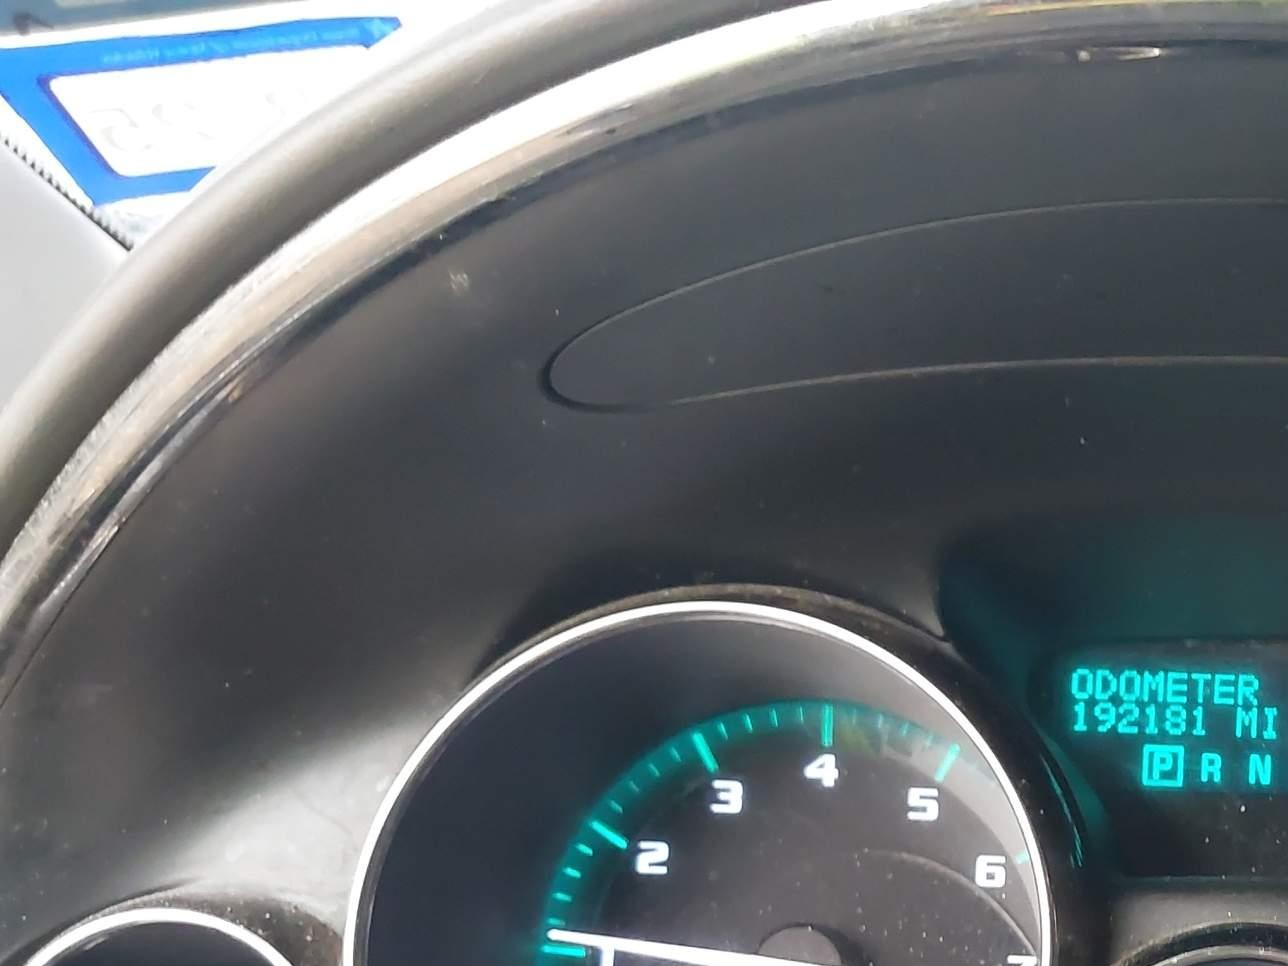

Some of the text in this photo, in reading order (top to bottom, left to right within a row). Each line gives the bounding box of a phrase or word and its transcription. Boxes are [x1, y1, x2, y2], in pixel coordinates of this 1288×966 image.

[1070, 667, 1260, 705] ODOMETER
[1073, 702, 1278, 740] 192181 MI
[804, 754, 839, 787] 4
[1151, 752, 1174, 782] P
[1200, 752, 1222, 783] R
[1248, 753, 1272, 785] N
[709, 779, 744, 814] 3
[907, 787, 939, 822] 5
[635, 840, 670, 875] 2
[974, 854, 1006, 888] 6
